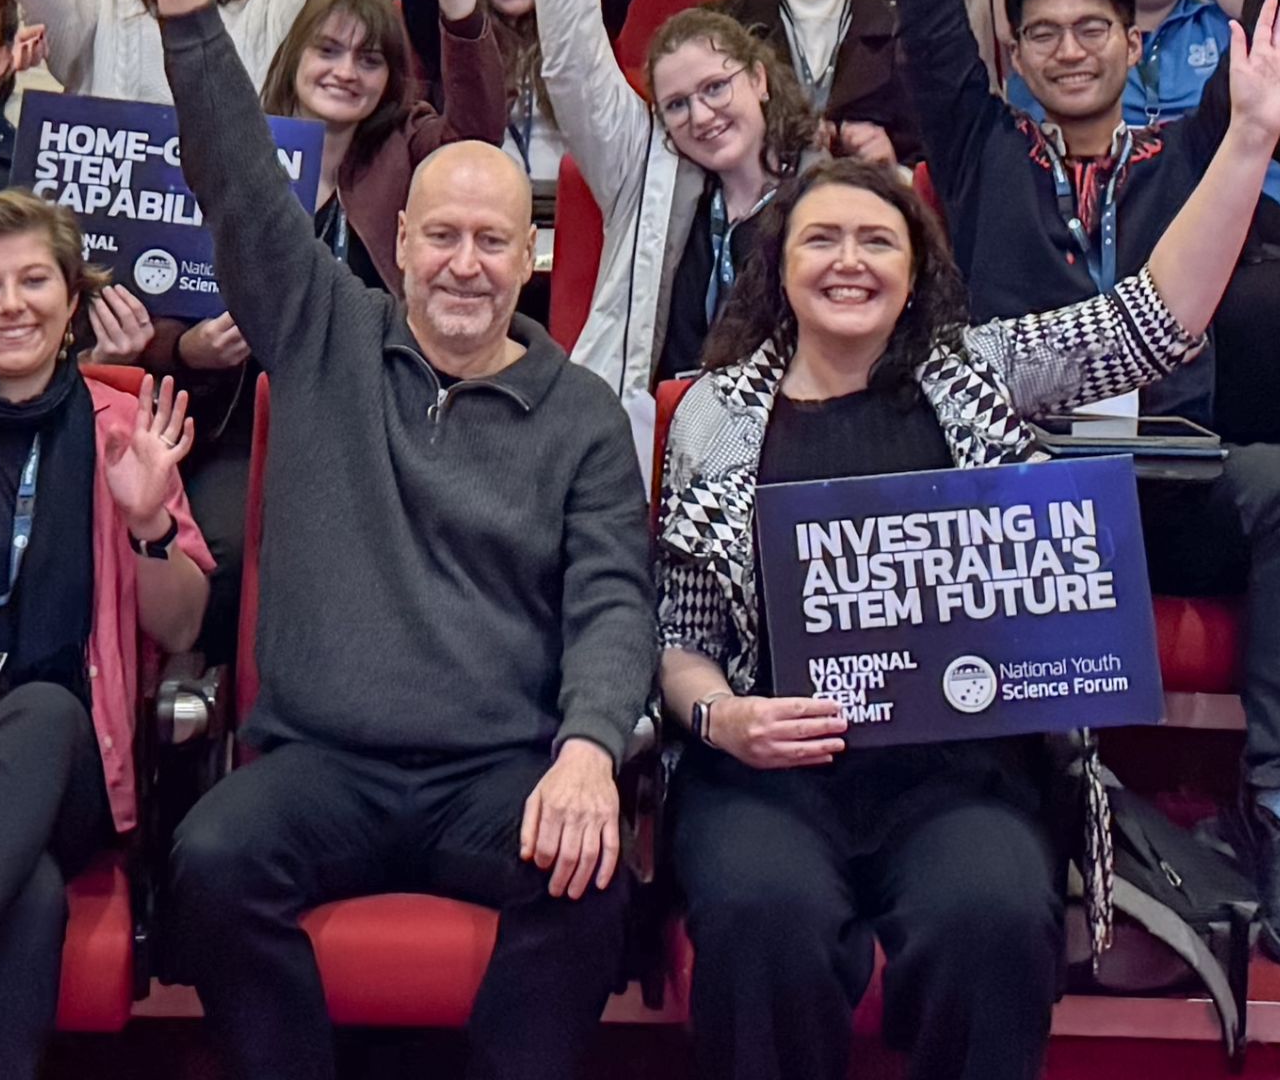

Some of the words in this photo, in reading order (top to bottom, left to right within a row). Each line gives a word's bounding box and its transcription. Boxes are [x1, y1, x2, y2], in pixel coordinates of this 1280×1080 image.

[35, 151, 133, 189] STEM
[178, 276, 220, 294] Scien
[796, 504, 1036, 560] INVESTING
[1047, 499, 1096, 539] IN
[802, 536, 1100, 597] AUSTRALIA'S
[802, 587, 923, 633] STEM
[936, 571, 1117, 623] FUTURE
[808, 651, 918, 676] NATIONAL
[999, 658, 1067, 680] National
[1071, 653, 1122, 674] Youth
[809, 670, 885, 693] YOUTH
[1001, 680, 1070, 701] Science
[1073, 676, 1129, 695] Forum
[840, 702, 894, 724] MMIT
